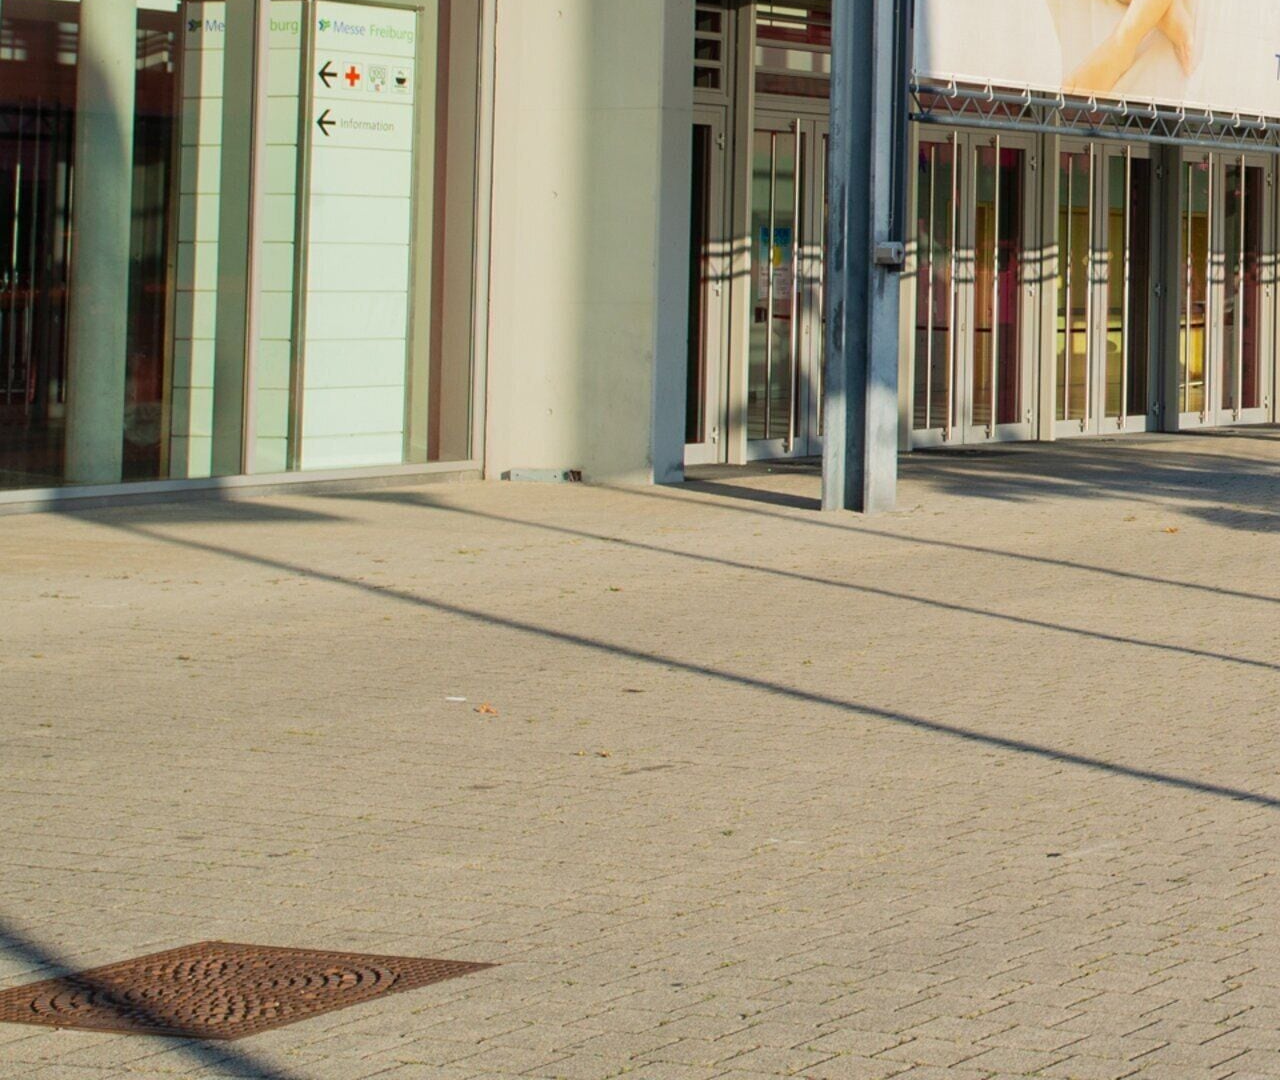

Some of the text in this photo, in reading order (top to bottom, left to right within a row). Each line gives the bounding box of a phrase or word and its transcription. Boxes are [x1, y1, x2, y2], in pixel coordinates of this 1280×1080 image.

[333, 21, 414, 43] Messe Freiburg
[340, 118, 394, 132] Information
